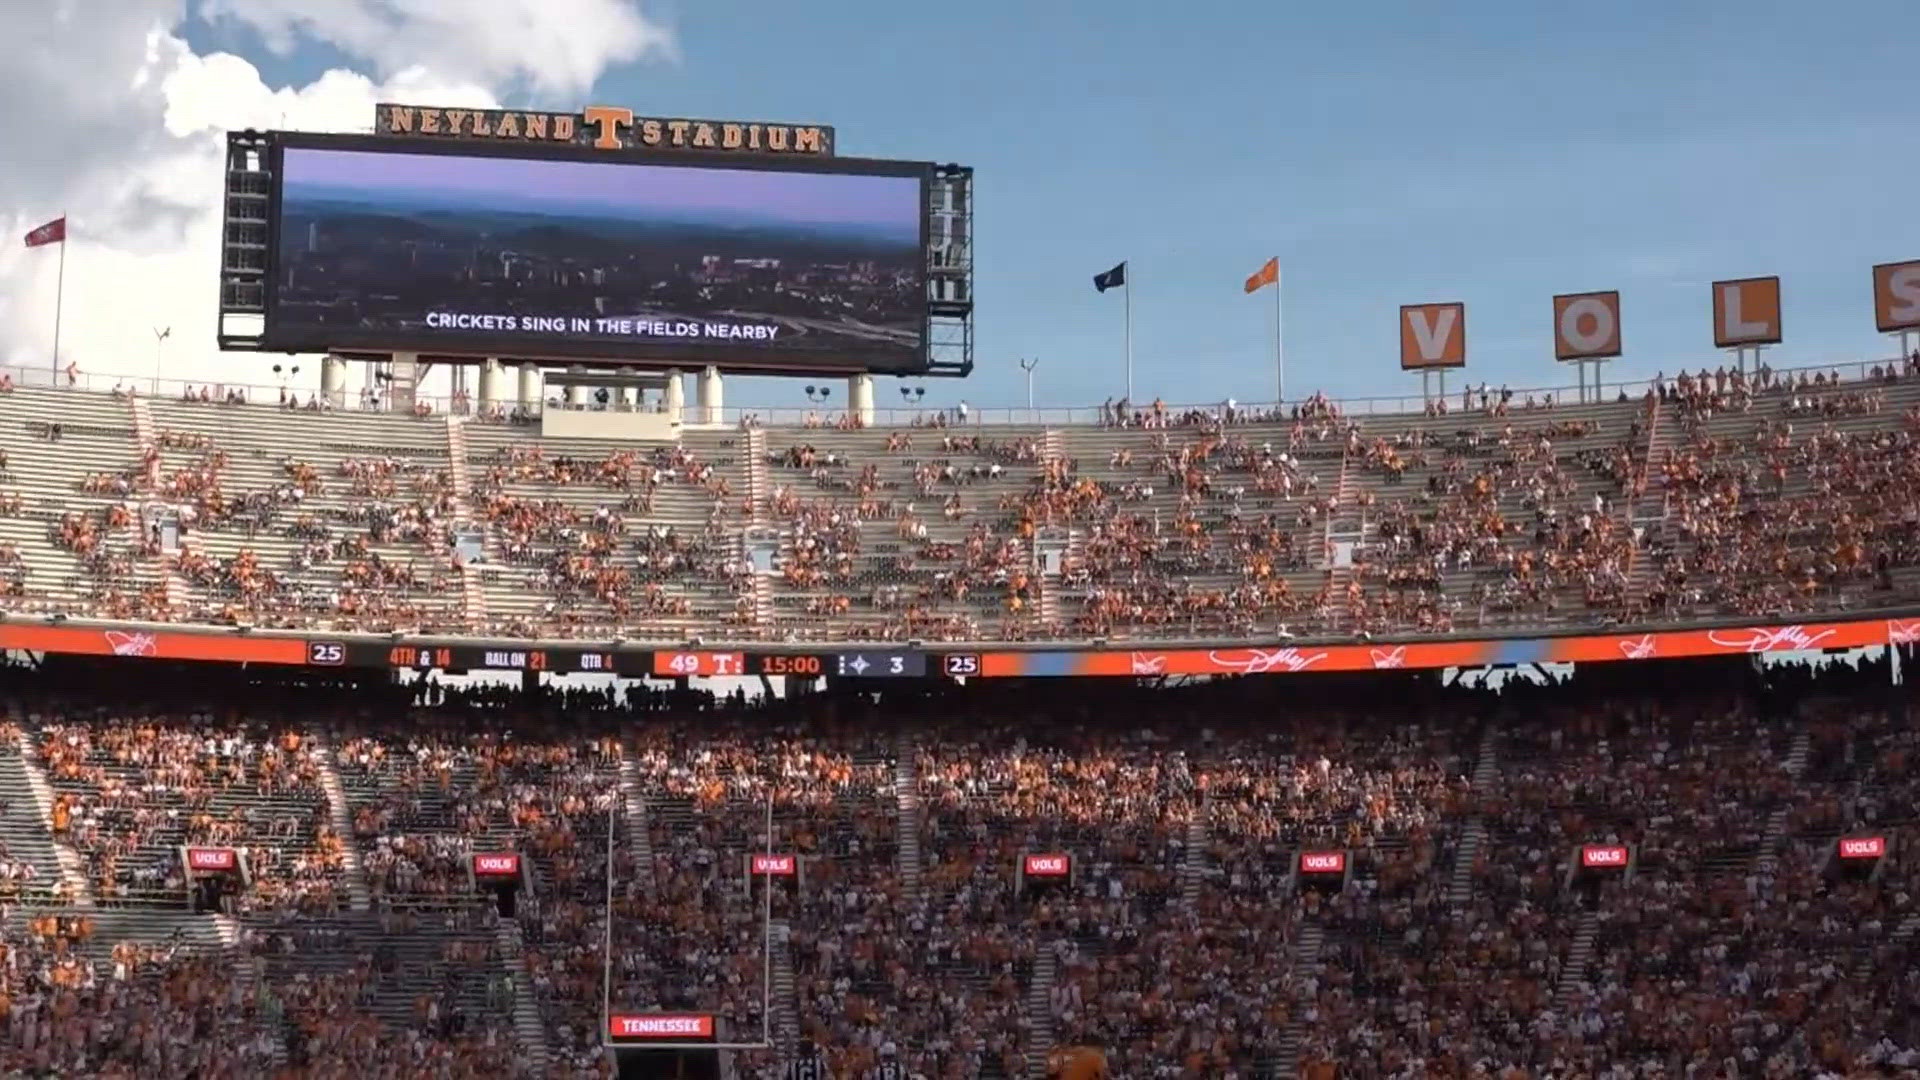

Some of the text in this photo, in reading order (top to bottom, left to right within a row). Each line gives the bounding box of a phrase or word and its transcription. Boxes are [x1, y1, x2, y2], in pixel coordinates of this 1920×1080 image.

[390, 105, 822, 154] NEYLAND T STADIUM
[426, 311, 779, 340] CRICKETS SING IN THE FIELDS NEARBY
[1407, 308, 1457, 360] V
[1560, 299, 1614, 351] O
[1725, 286, 1770, 339] L
[312, 645, 342, 661] 25
[390, 647, 416, 665] 4TH
[420, 650, 430, 666] &
[485, 651, 547, 669] BALL ON 21
[581, 653, 613, 669] QTR 4
[669, 654, 699, 671] 49
[762, 655, 820, 674] 15:00
[889, 656, 904, 674] 3
[949, 656, 977, 672] 25
[1845, 841, 1878, 854] VOLS
[195, 853, 227, 865] VOLS
[480, 858, 512, 870] VOLS
[757, 858, 788, 870] VOLS
[1031, 858, 1062, 870] VOLS
[1306, 856, 1338, 868] VOLS
[1588, 850, 1620, 862] VOLS
[621, 1018, 702, 1033] TENNESSEE
